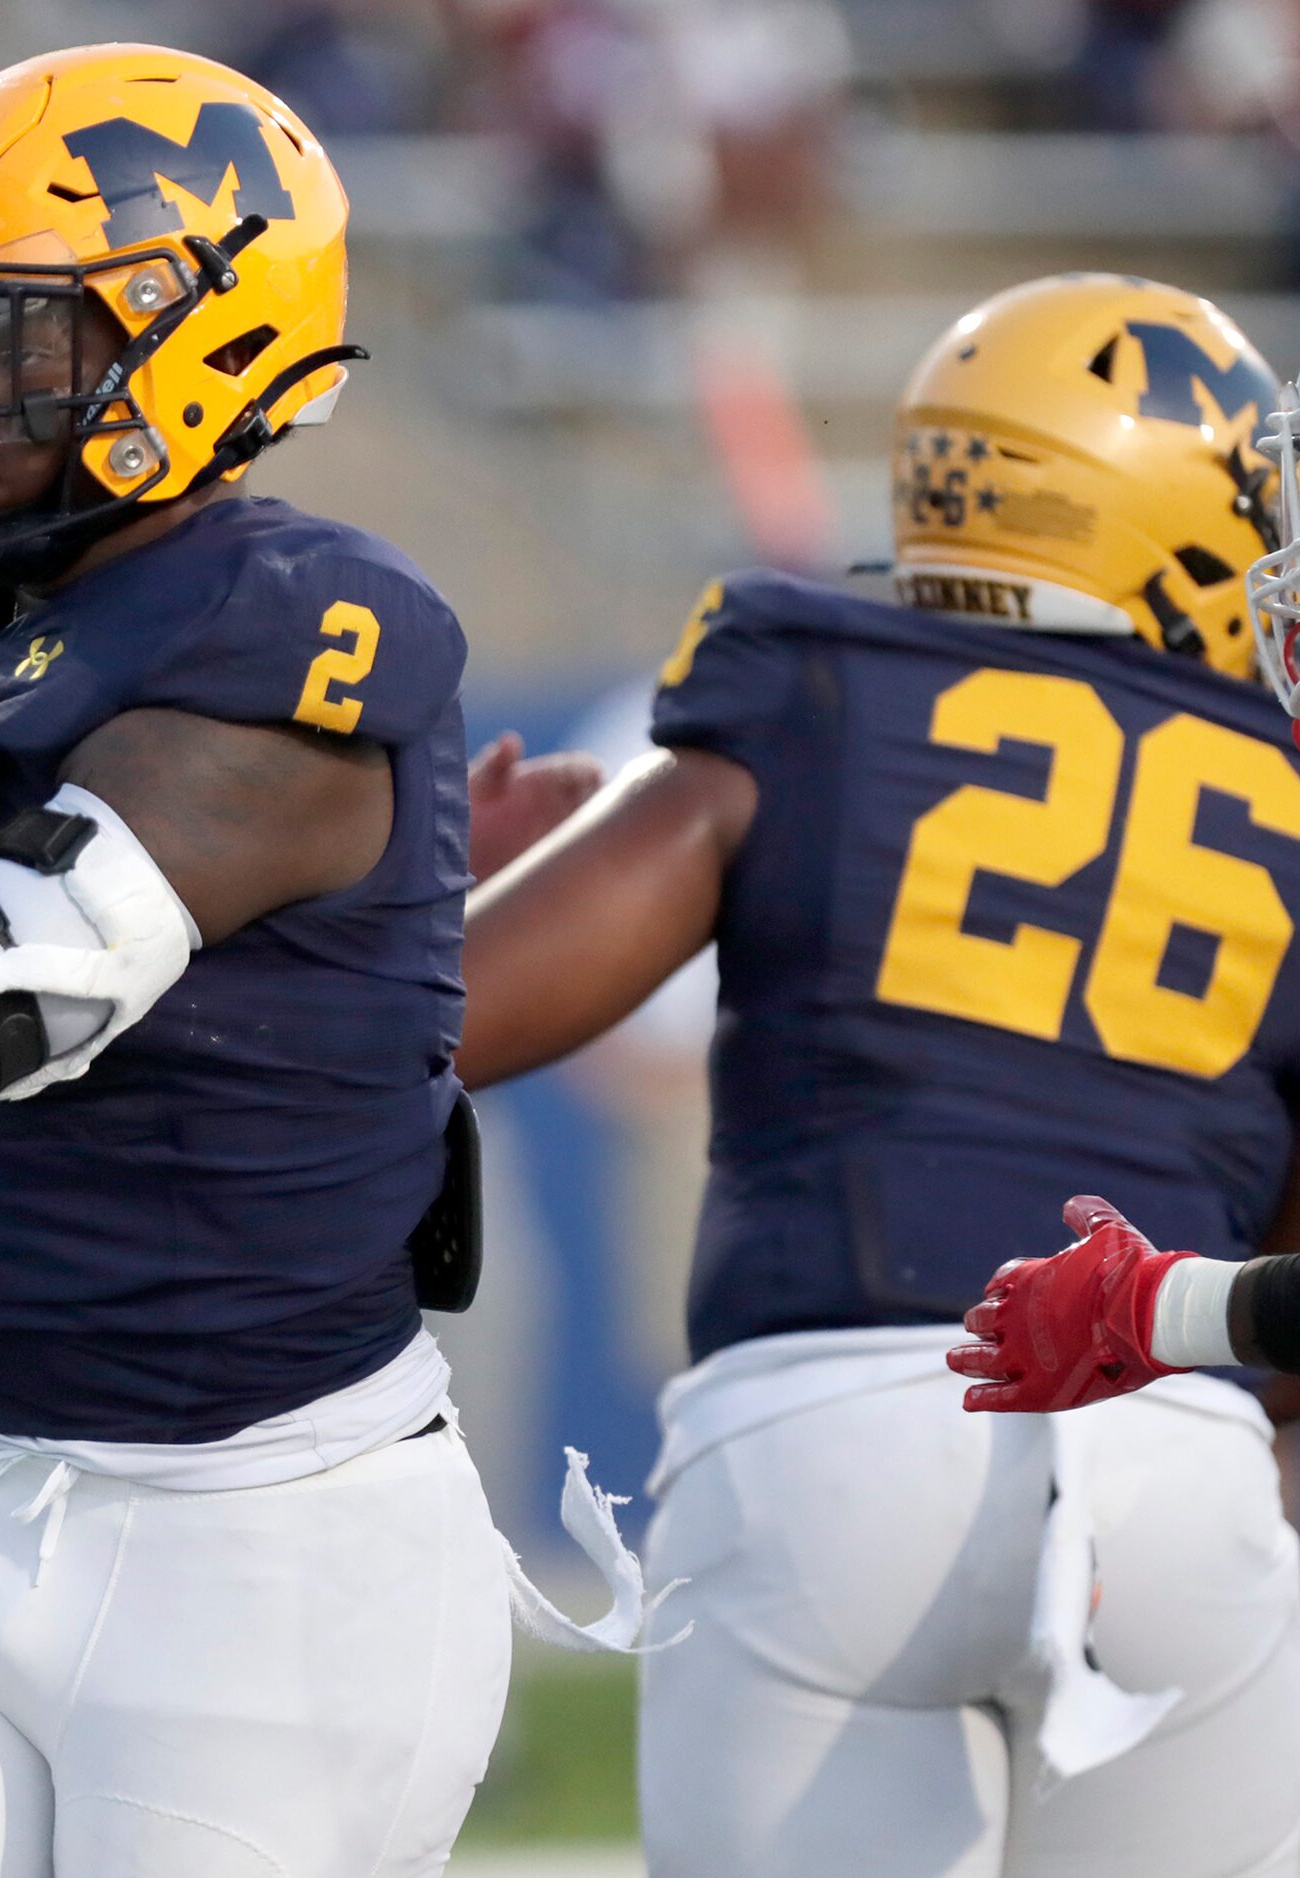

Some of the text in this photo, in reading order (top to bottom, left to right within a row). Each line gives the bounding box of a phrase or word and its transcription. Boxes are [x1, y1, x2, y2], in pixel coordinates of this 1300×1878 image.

[62, 101, 296, 250] M
[1124, 322, 1282, 467] M
[292, 600, 381, 734] 2
[875, 667, 1300, 1081] 26
